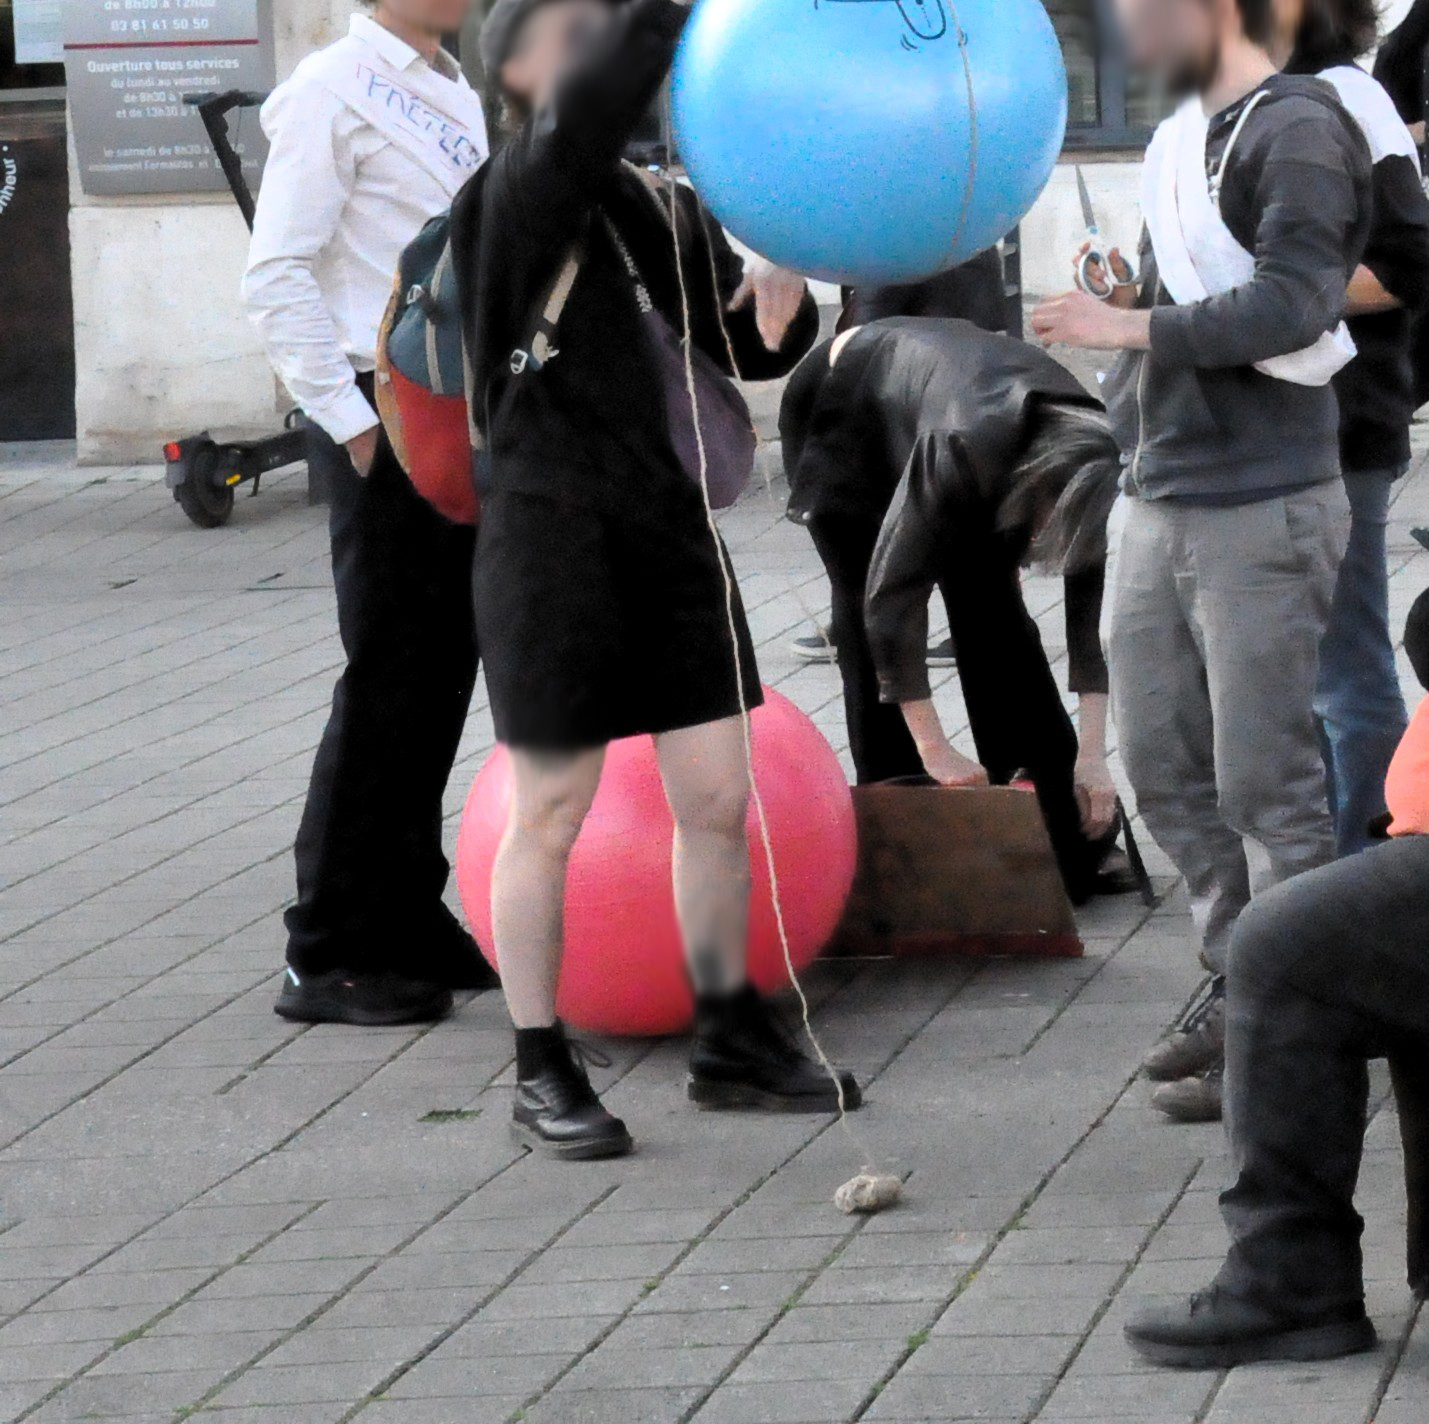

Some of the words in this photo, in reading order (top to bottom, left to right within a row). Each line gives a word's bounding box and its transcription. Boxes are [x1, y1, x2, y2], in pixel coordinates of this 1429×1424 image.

[87, 60, 151, 74] Ouverture
[155, 58, 183, 71] tous
[186, 57, 239, 70] services
